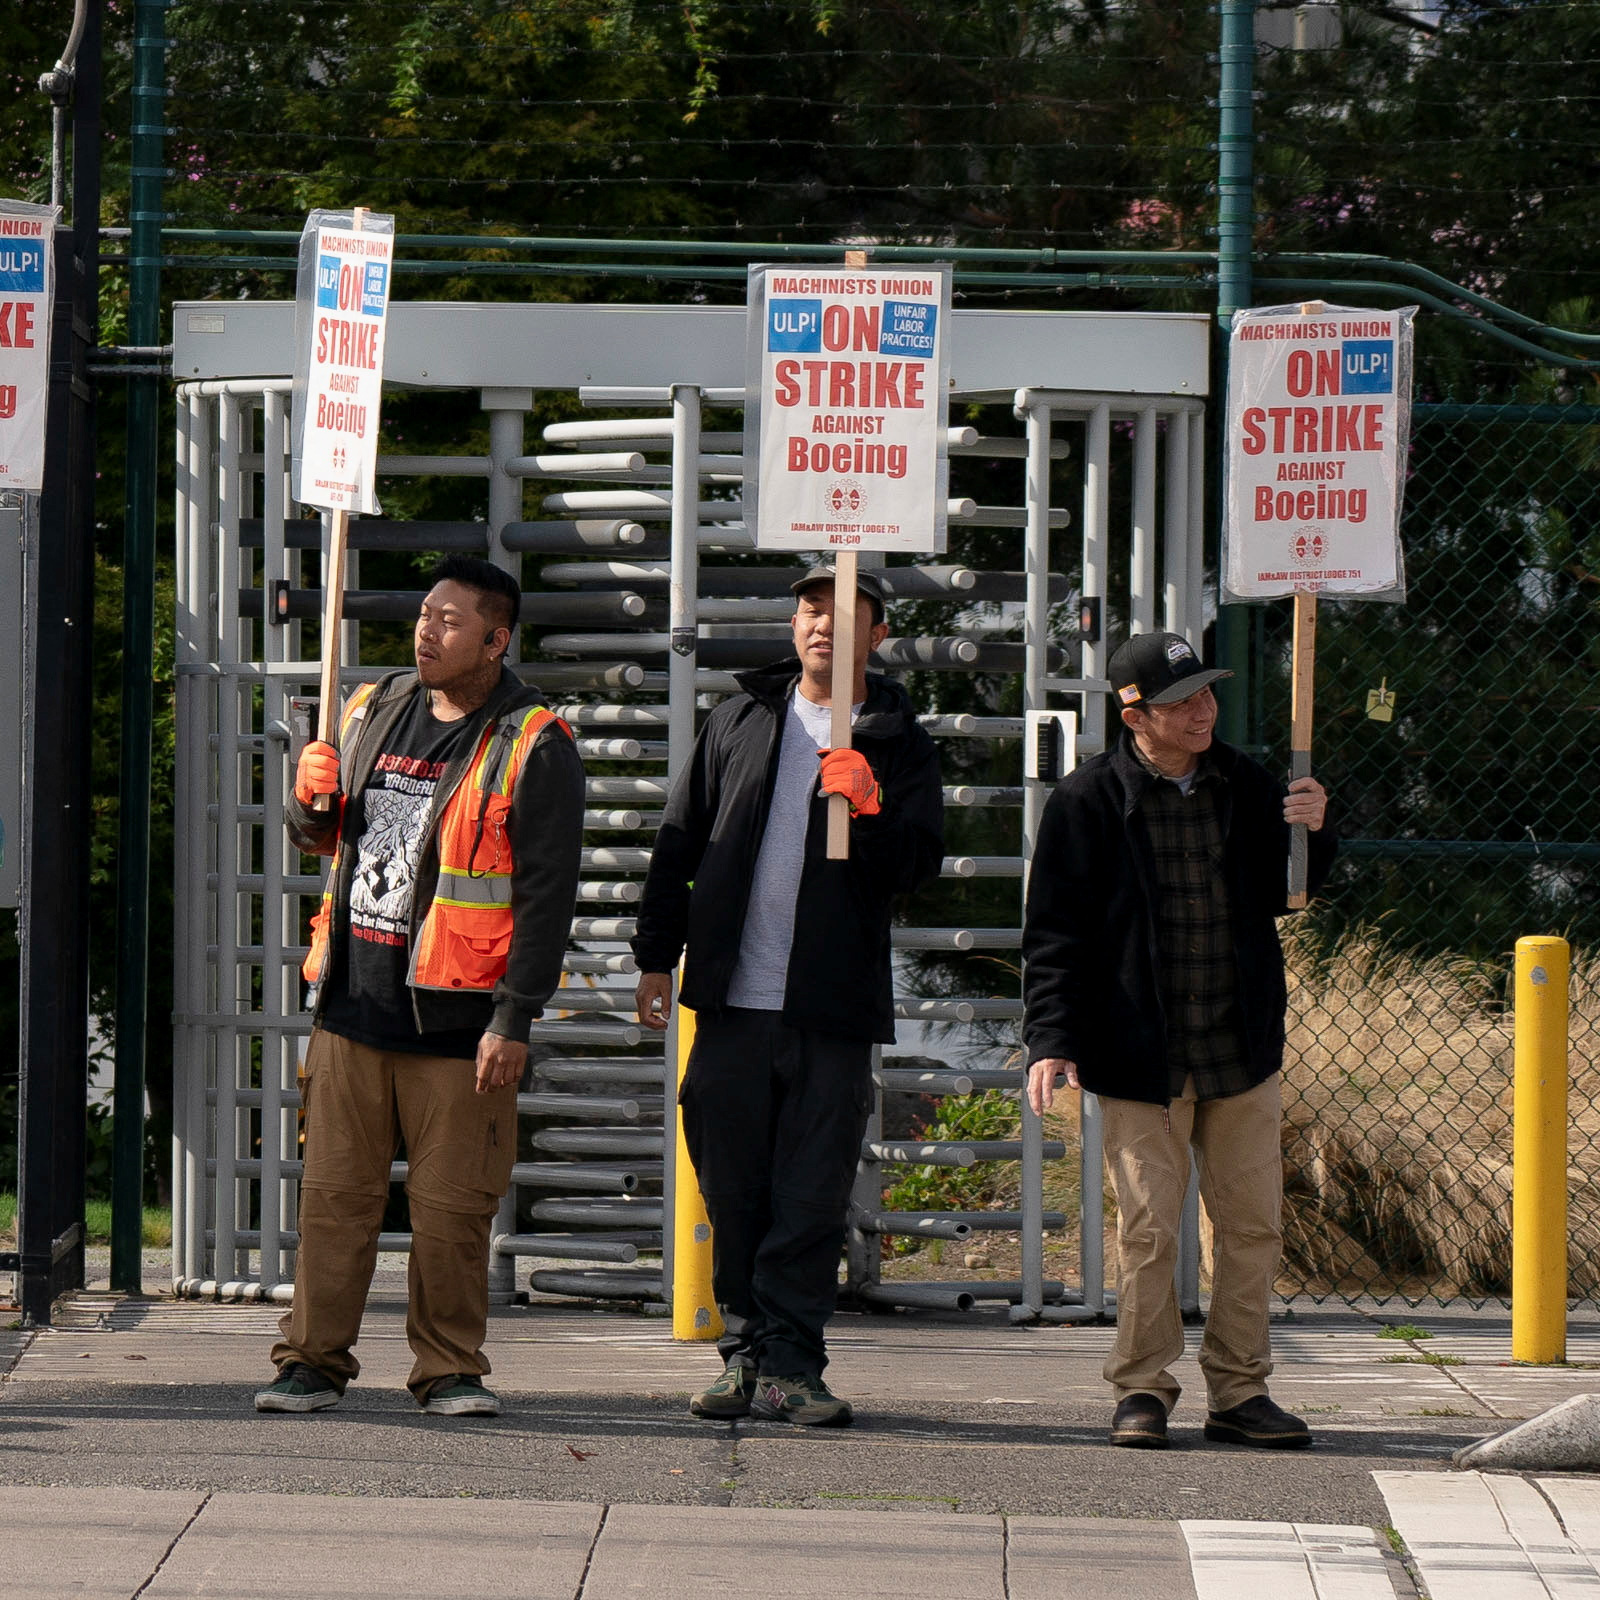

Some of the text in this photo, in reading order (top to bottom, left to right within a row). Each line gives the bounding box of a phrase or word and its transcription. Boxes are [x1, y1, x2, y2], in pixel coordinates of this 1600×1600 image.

[321, 235, 388, 257] MACHINISTS UNION
[320, 264, 364, 312] ULP! ON
[773, 278, 933, 296] MACHINISTS UNION
[893, 304, 926, 319] UNFAIR
[774, 304, 880, 352] ULP! ON
[893, 318, 924, 333] LABOR
[1240, 321, 1391, 341] MACHINISTS UNION
[317, 317, 379, 370] STRIKE
[881, 332, 933, 349] PRACTICES!
[329, 373, 360, 394] AGAINST
[775, 359, 924, 409] STRIKE
[1286, 349, 1388, 398] ON ULP!
[317, 393, 367, 439] Boeing
[812, 415, 885, 435] AGAINST
[1242, 405, 1383, 455] STRIKE
[788, 436, 908, 479] Boeing
[1277, 461, 1346, 481] AGAINST
[1254, 484, 1367, 523] Boeing
[825, 523, 860, 533] DISTRICT
[862, 524, 885, 534] LODGE
[887, 525, 900, 534] 751
[829, 534, 861, 544] AFL-CIO
[1289, 571, 1323, 580] DISTRICT
[1324, 570, 1347, 579] LODGE
[1348, 569, 1361, 579] 751
